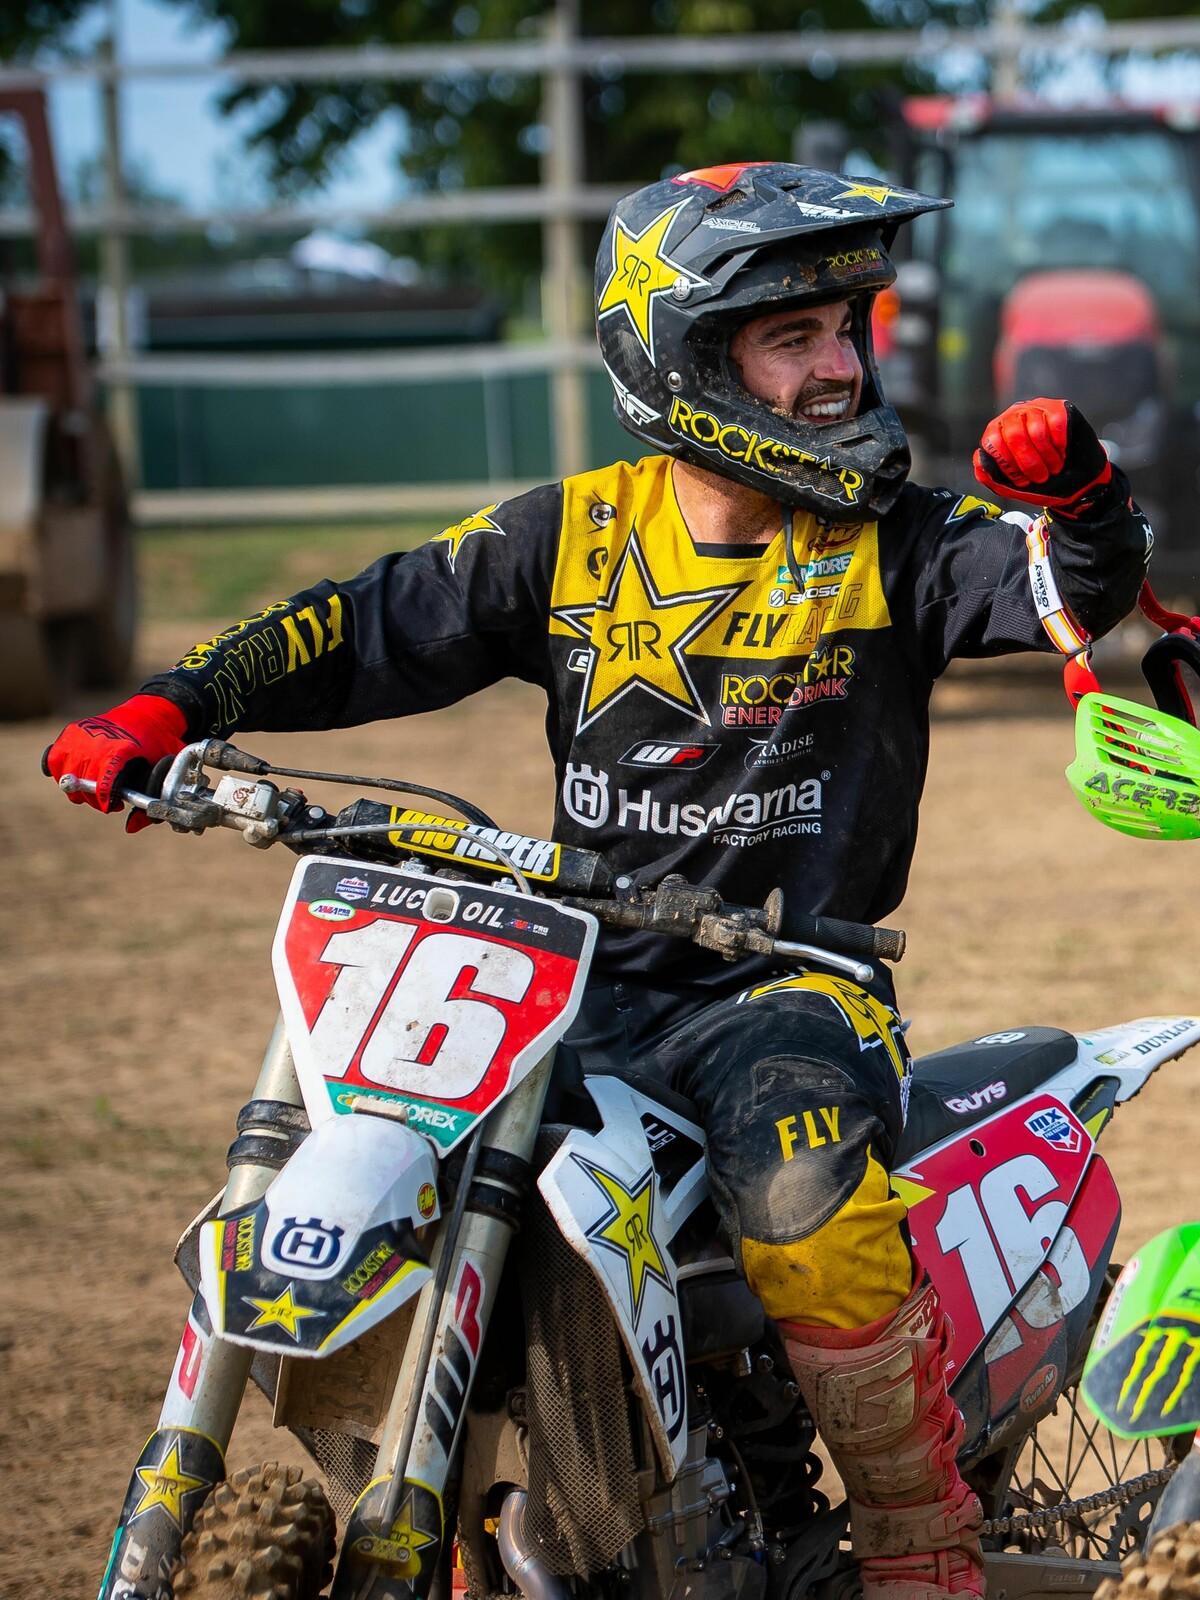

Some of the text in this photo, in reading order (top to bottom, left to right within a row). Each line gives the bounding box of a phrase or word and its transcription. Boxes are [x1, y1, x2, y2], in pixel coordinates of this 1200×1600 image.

[722, 611, 789, 647] FLY
[632, 745, 705, 764] WP
[617, 778, 822, 837] Husvarna
[713, 823, 822, 847] FACTORY RACING
[371, 883, 503, 929] LUC OIL
[310, 917, 535, 1100] 16
[1132, 1019, 1198, 1056] DUNLOP
[945, 1081, 1007, 1114] GUTS
[774, 1106, 841, 1162] FLY
[1028, 1108, 1063, 1132] MX
[935, 1153, 1091, 1363] 16
